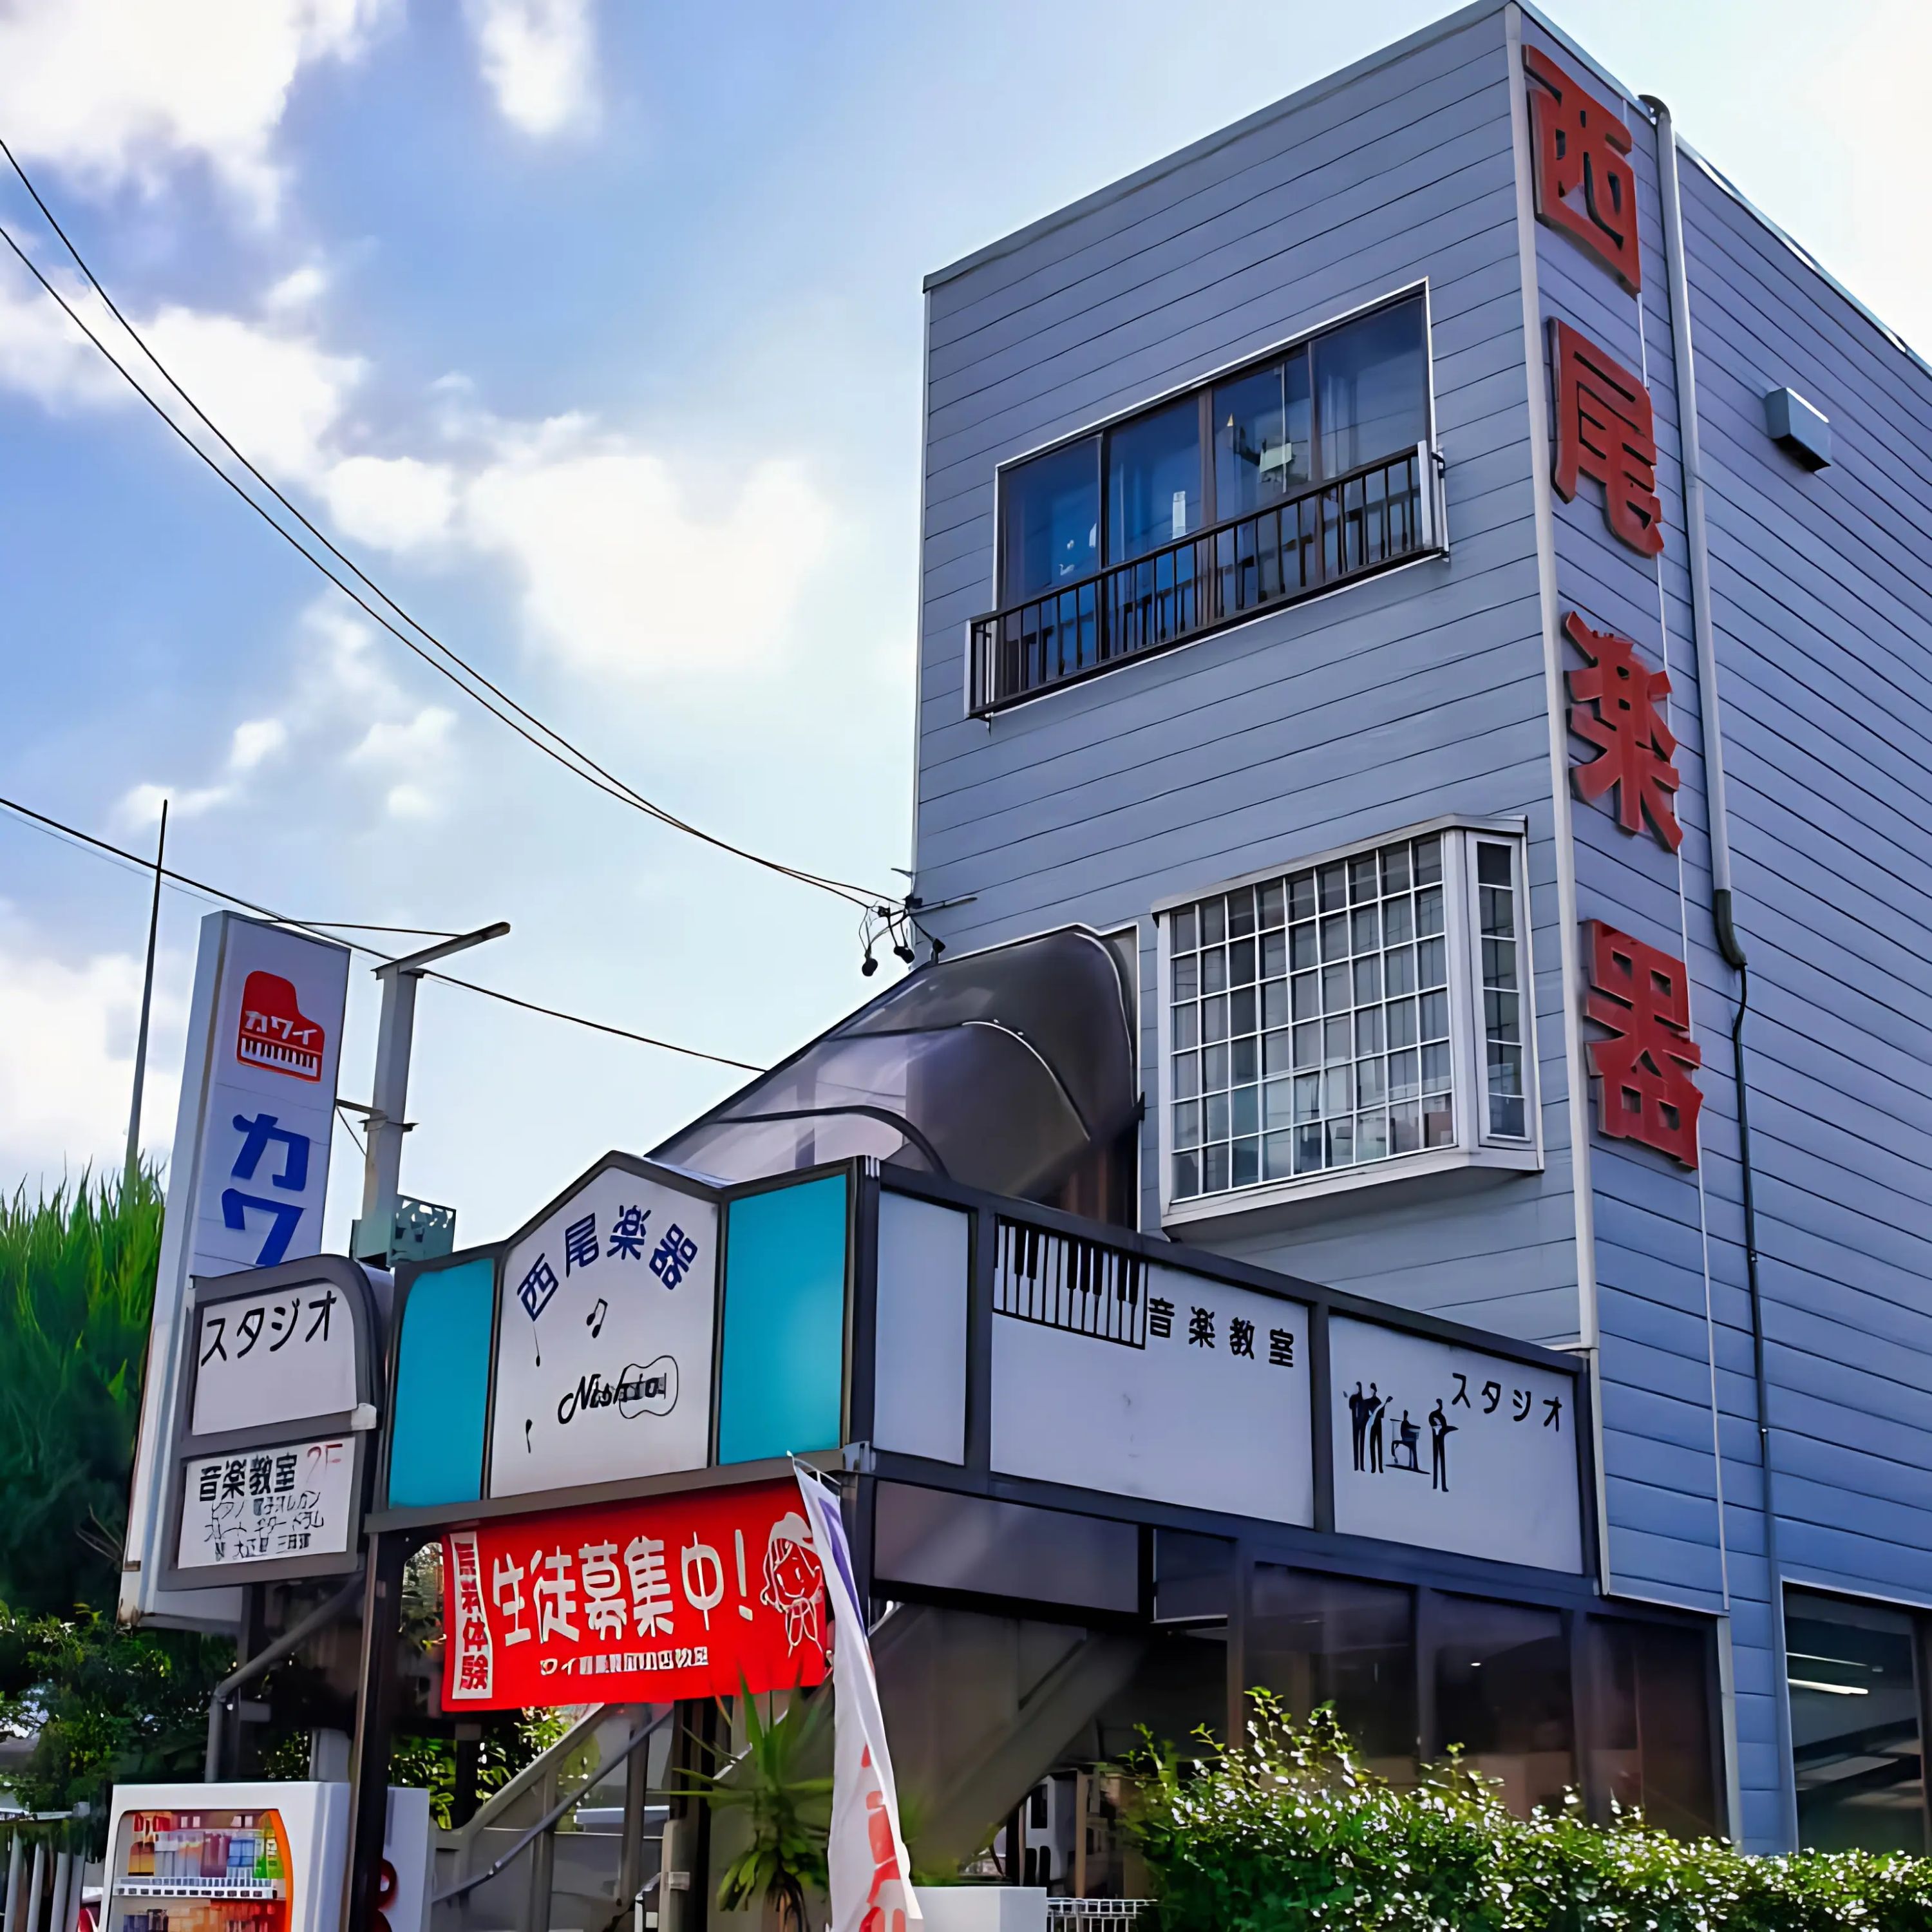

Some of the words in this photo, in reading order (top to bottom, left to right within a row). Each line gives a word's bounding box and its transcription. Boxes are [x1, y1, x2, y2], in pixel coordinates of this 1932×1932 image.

[1522, 44, 1703, 1171] 西尾楽器
[245, 1010, 317, 1045] カワイ
[517, 1205, 698, 1321] 西尾楽器
[200, 1290, 337, 1367] スタジオ
[1148, 1297, 1294, 1368] 音楽教室
[200, 1452, 298, 1501] 音楽教室
